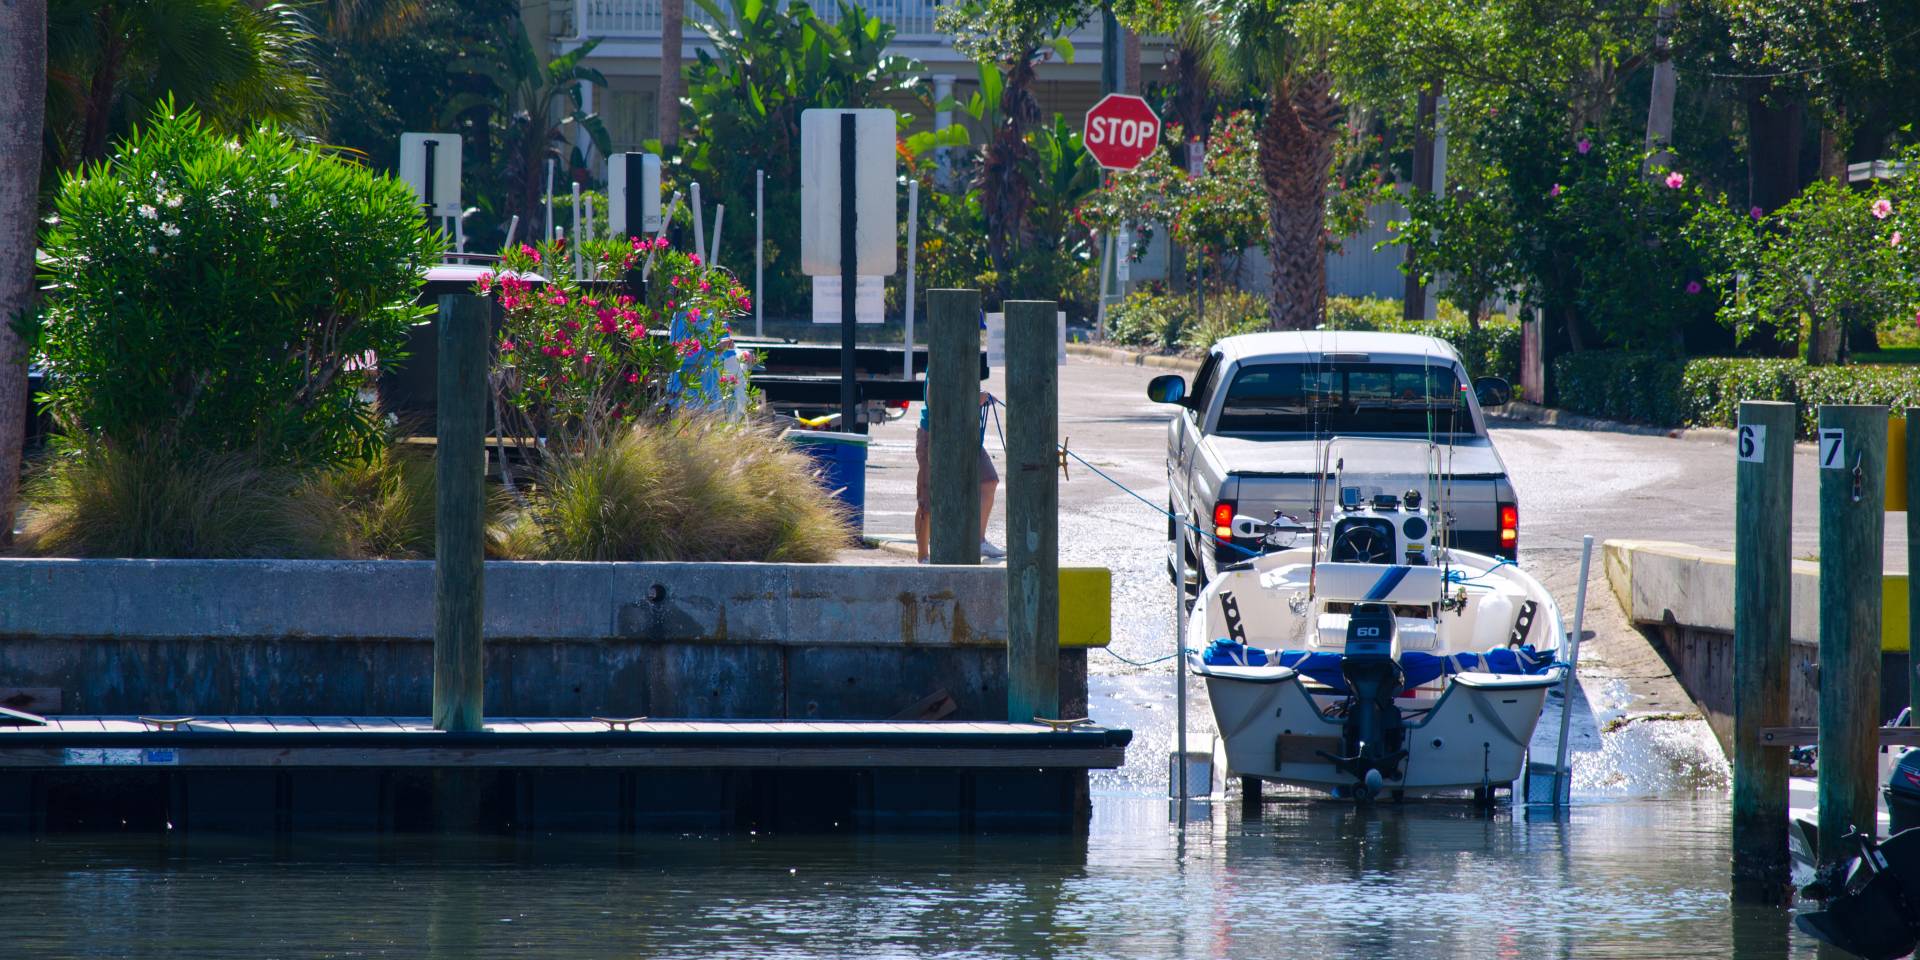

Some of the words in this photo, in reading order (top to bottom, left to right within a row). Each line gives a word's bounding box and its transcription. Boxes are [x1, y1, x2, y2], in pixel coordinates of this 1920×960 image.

[1089, 116, 1154, 148] STOP
[1739, 425, 1754, 458] 6
[1824, 432, 1842, 465] 7
[1357, 627, 1380, 637] 60
